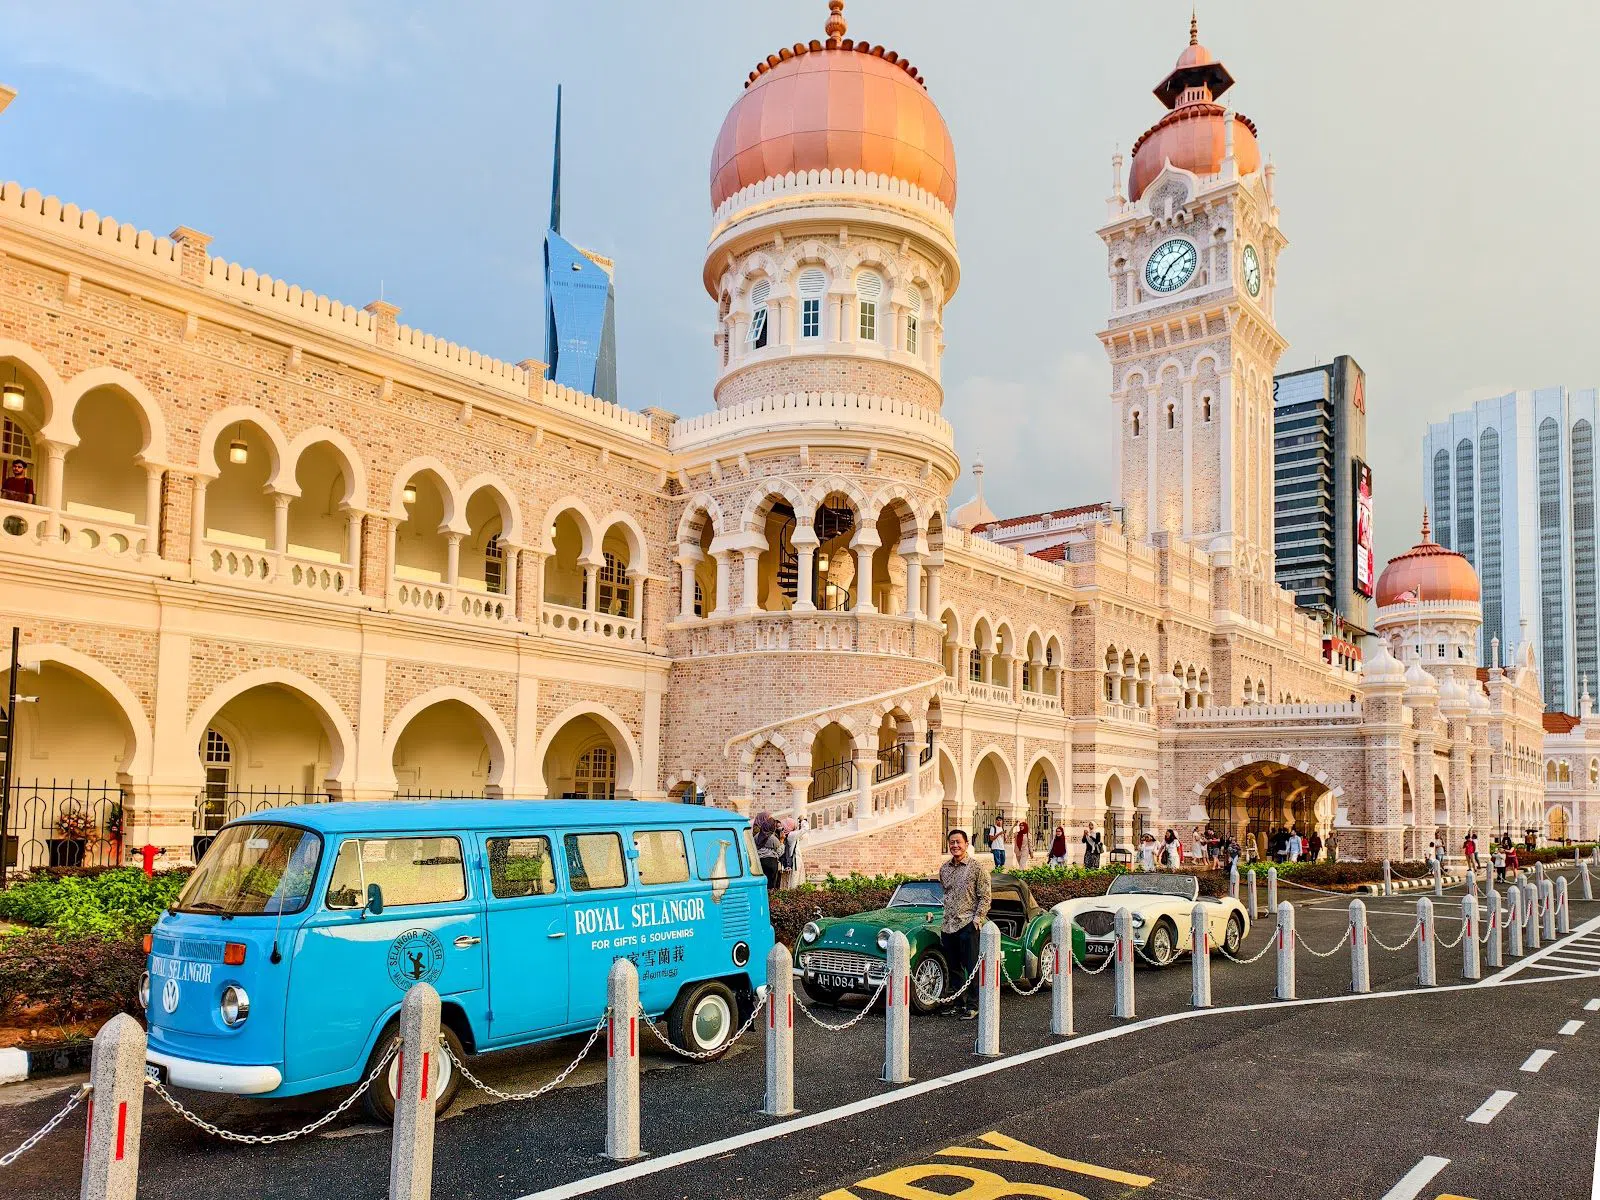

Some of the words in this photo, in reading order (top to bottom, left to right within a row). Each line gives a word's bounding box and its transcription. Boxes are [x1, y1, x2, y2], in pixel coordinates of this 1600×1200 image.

[574, 906, 624, 935] ROYAL
[631, 897, 706, 928] SELANGOR
[390, 931, 418, 966] SELANGOR
[422, 931, 443, 960] PEWTER
[591, 939, 610, 950] FOR
[613, 935, 637, 947] GIFTS
[640, 934, 647, 943] &
[649, 928, 695, 943] SOUVENIRS
[1087, 944, 1109, 953] 9784
[169, 960, 212, 984] SELANGOR
[817, 974, 830, 986] AH
[831, 975, 855, 989] 1084
